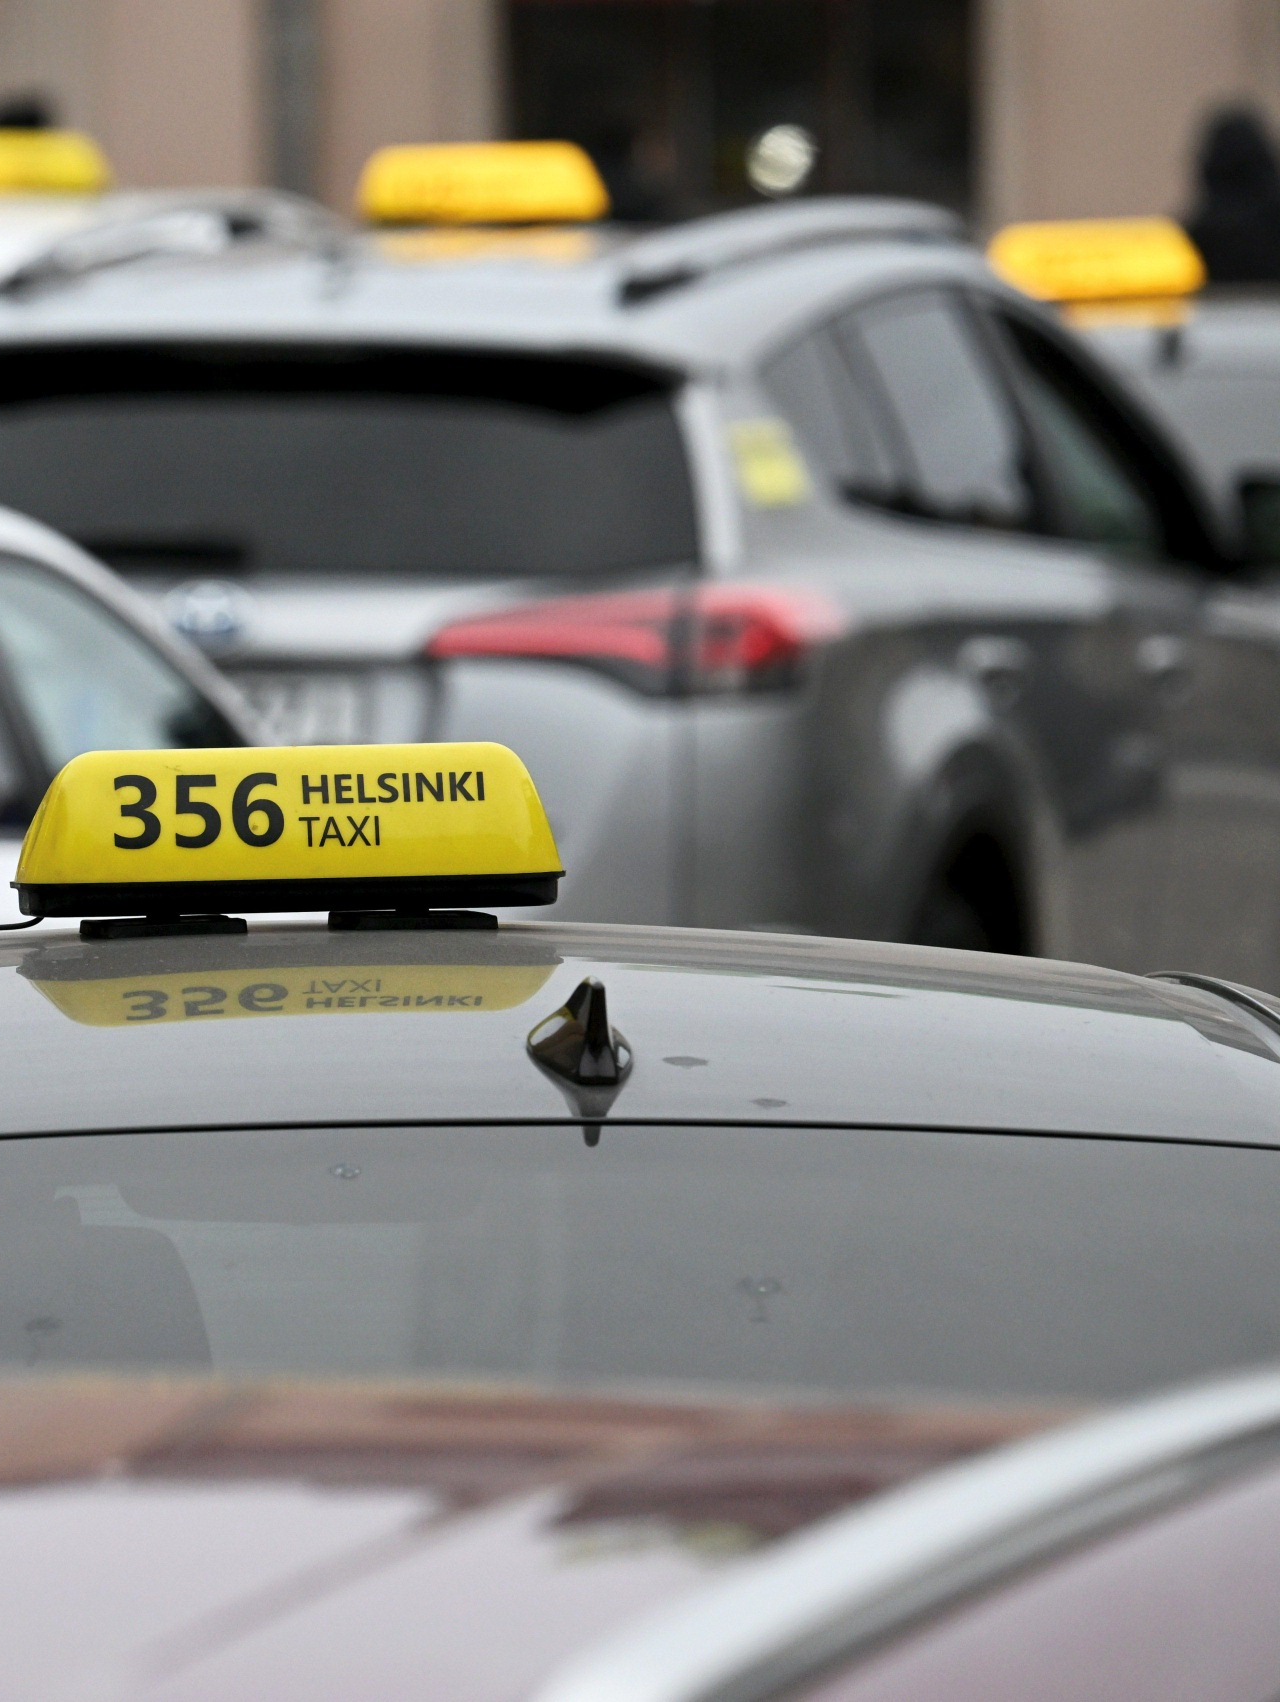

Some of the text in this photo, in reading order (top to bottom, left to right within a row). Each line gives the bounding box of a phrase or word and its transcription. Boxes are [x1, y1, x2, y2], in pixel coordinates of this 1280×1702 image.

[113, 771, 485, 850] 356 HELSINKI
[298, 815, 381, 848] TAXI
